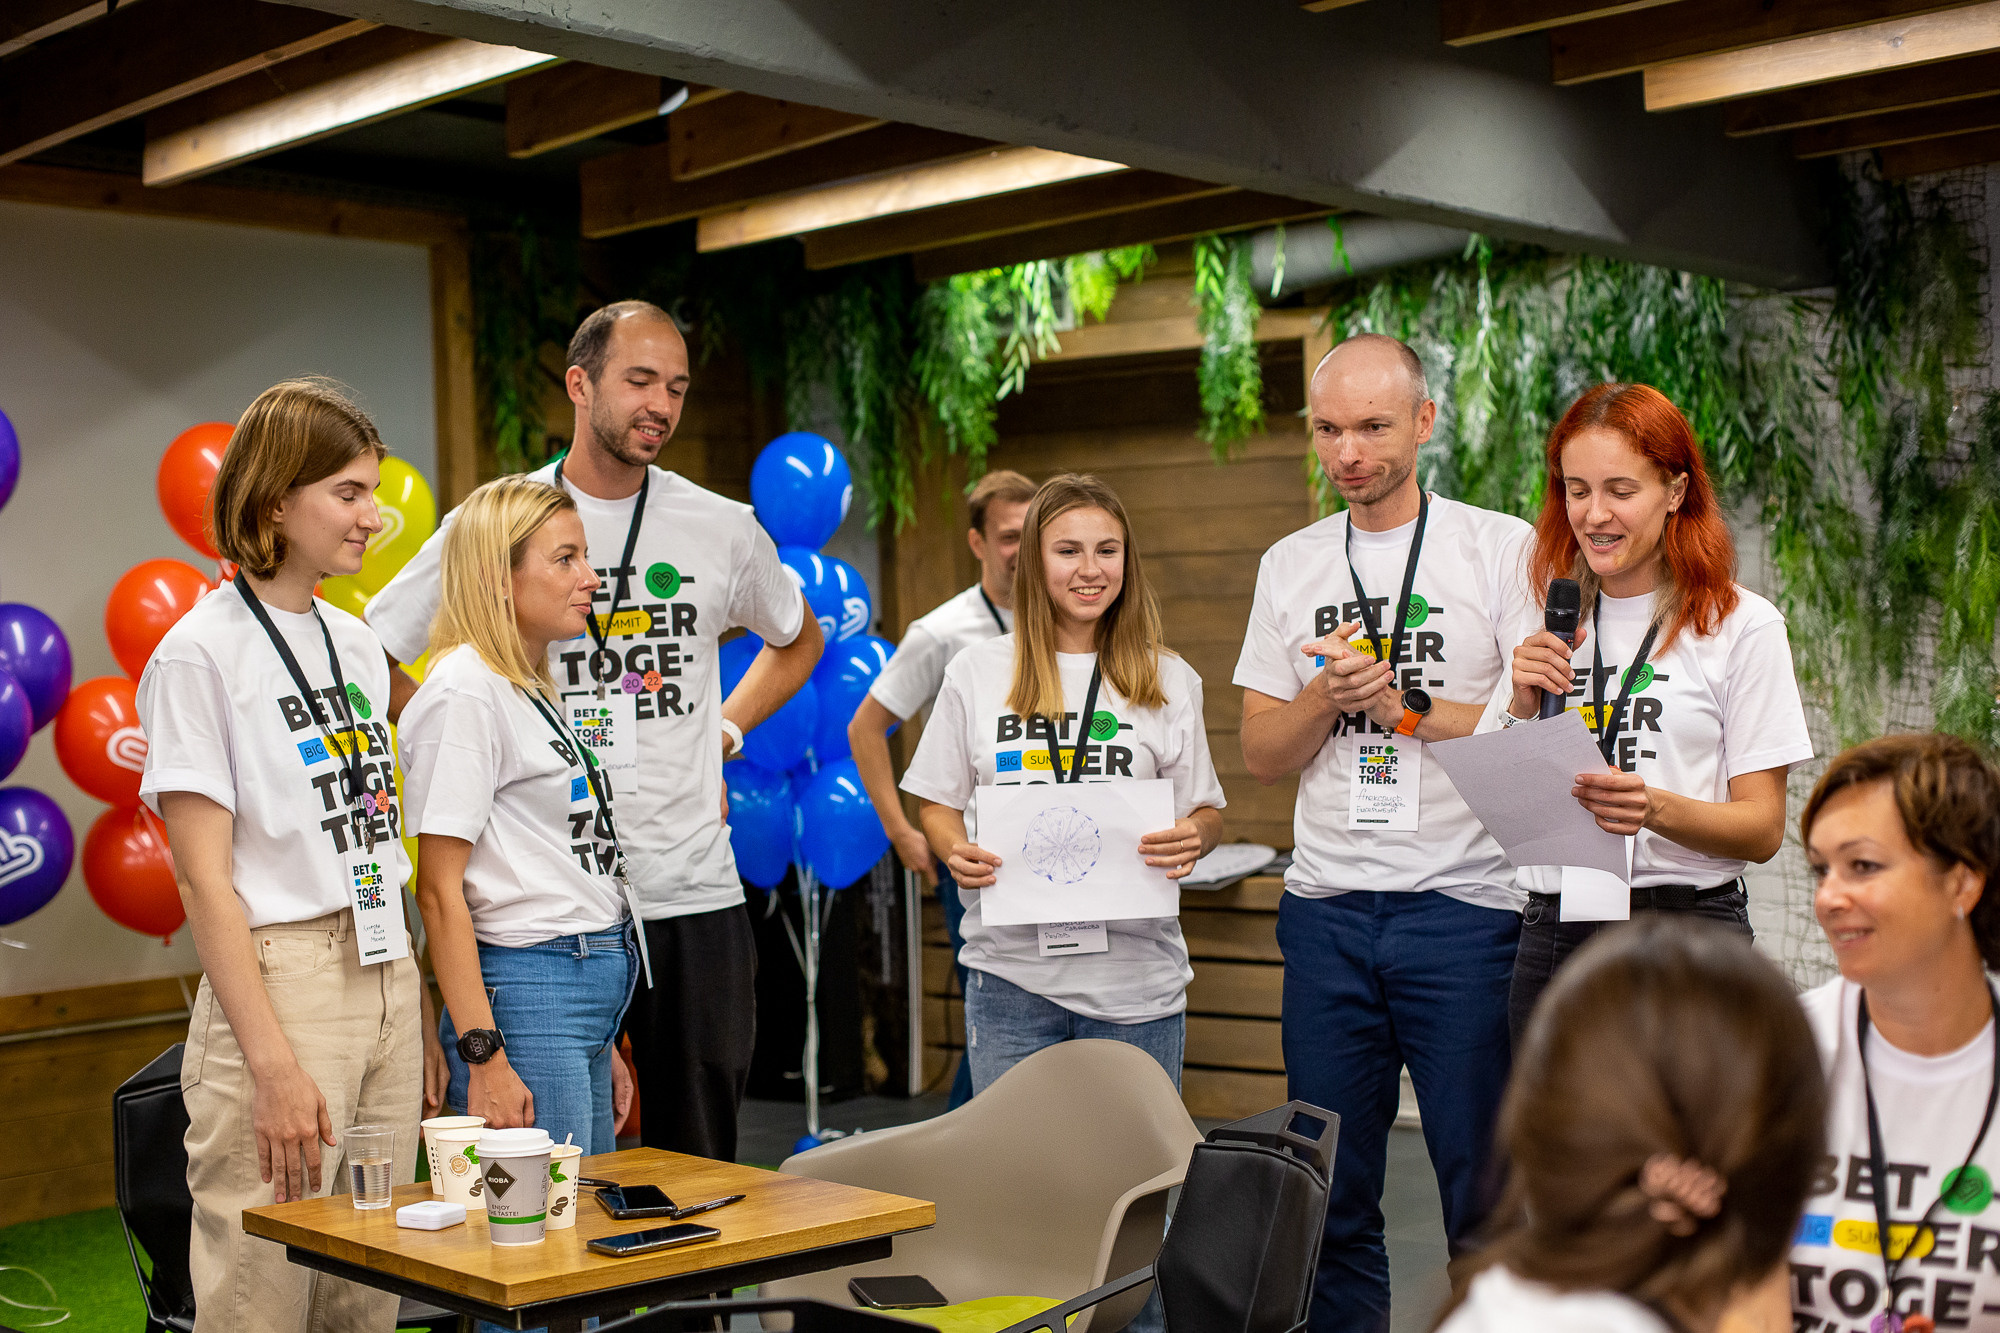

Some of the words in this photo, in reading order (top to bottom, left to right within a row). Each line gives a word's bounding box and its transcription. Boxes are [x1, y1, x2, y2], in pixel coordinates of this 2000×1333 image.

[591, 566, 637, 602] ET
[625, 679, 639, 689] 20
[647, 677, 660, 686] 22
[1566, 665, 1617, 697] ET
[304, 744, 324, 759] BIG
[1000, 756, 1018, 767] BIG
